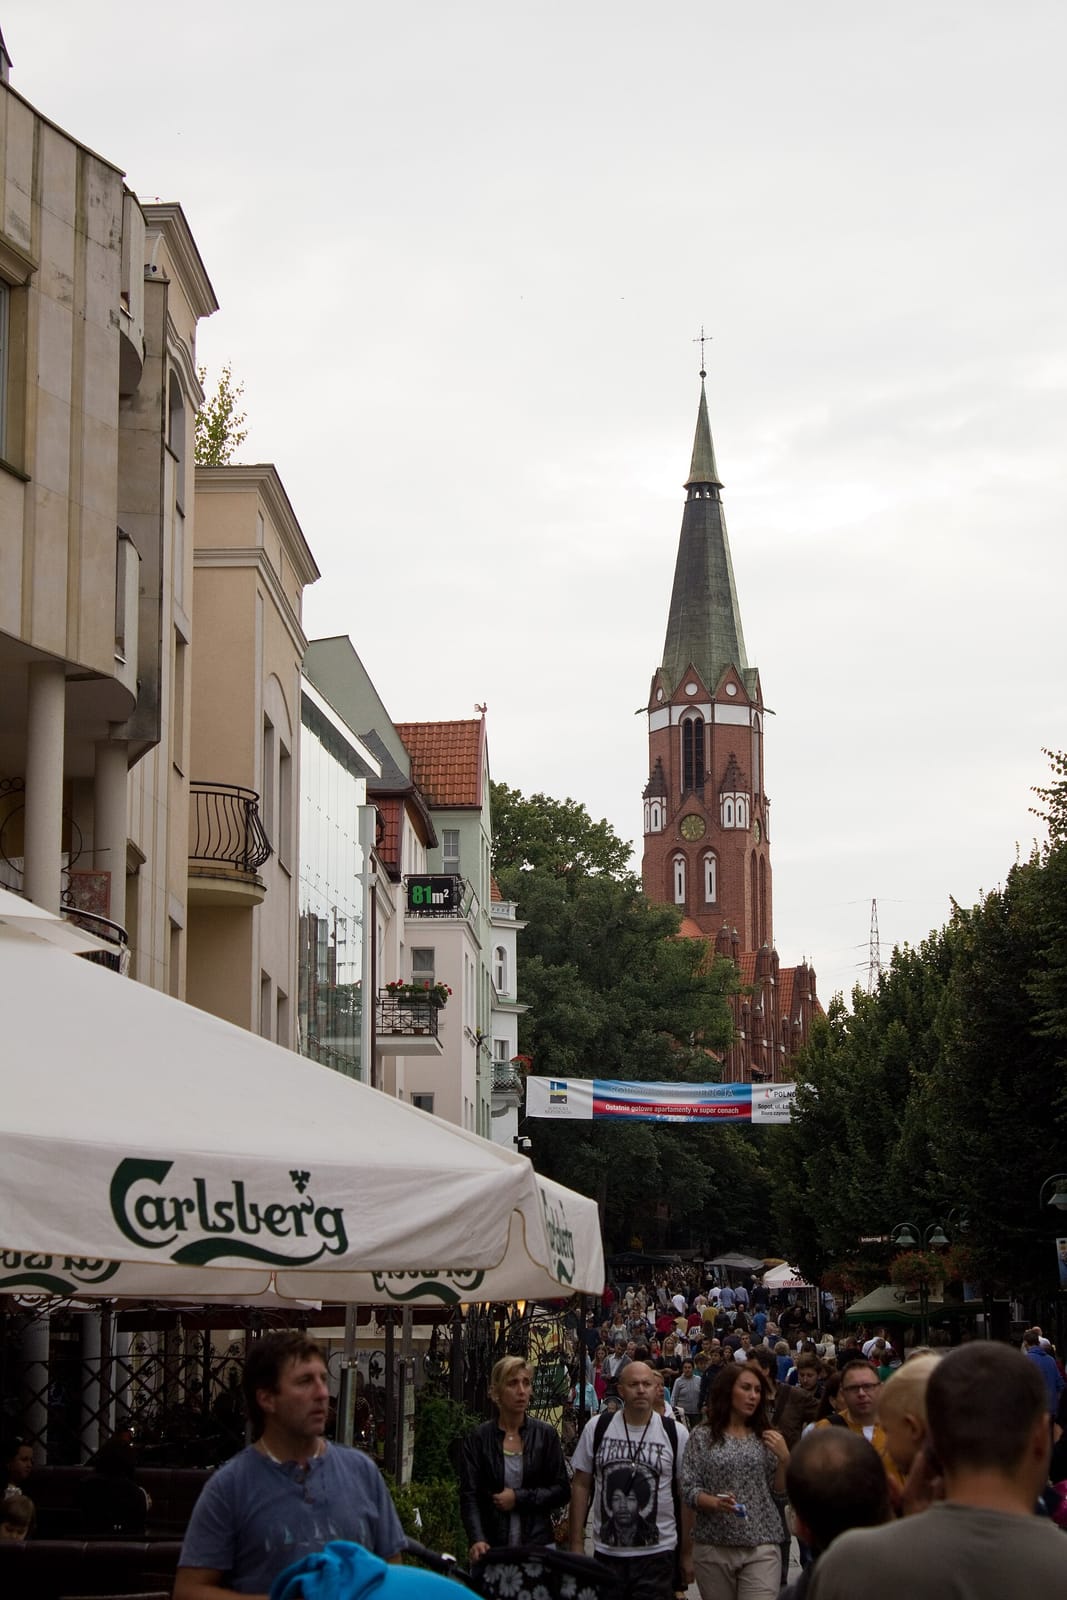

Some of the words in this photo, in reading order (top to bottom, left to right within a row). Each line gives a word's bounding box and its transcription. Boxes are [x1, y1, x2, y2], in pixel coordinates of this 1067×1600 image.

[605, 1103, 630, 1111] Ostatnie
[655, 1106, 691, 1114] apartamenty
[110, 1157, 349, 1256] Carlsberg
